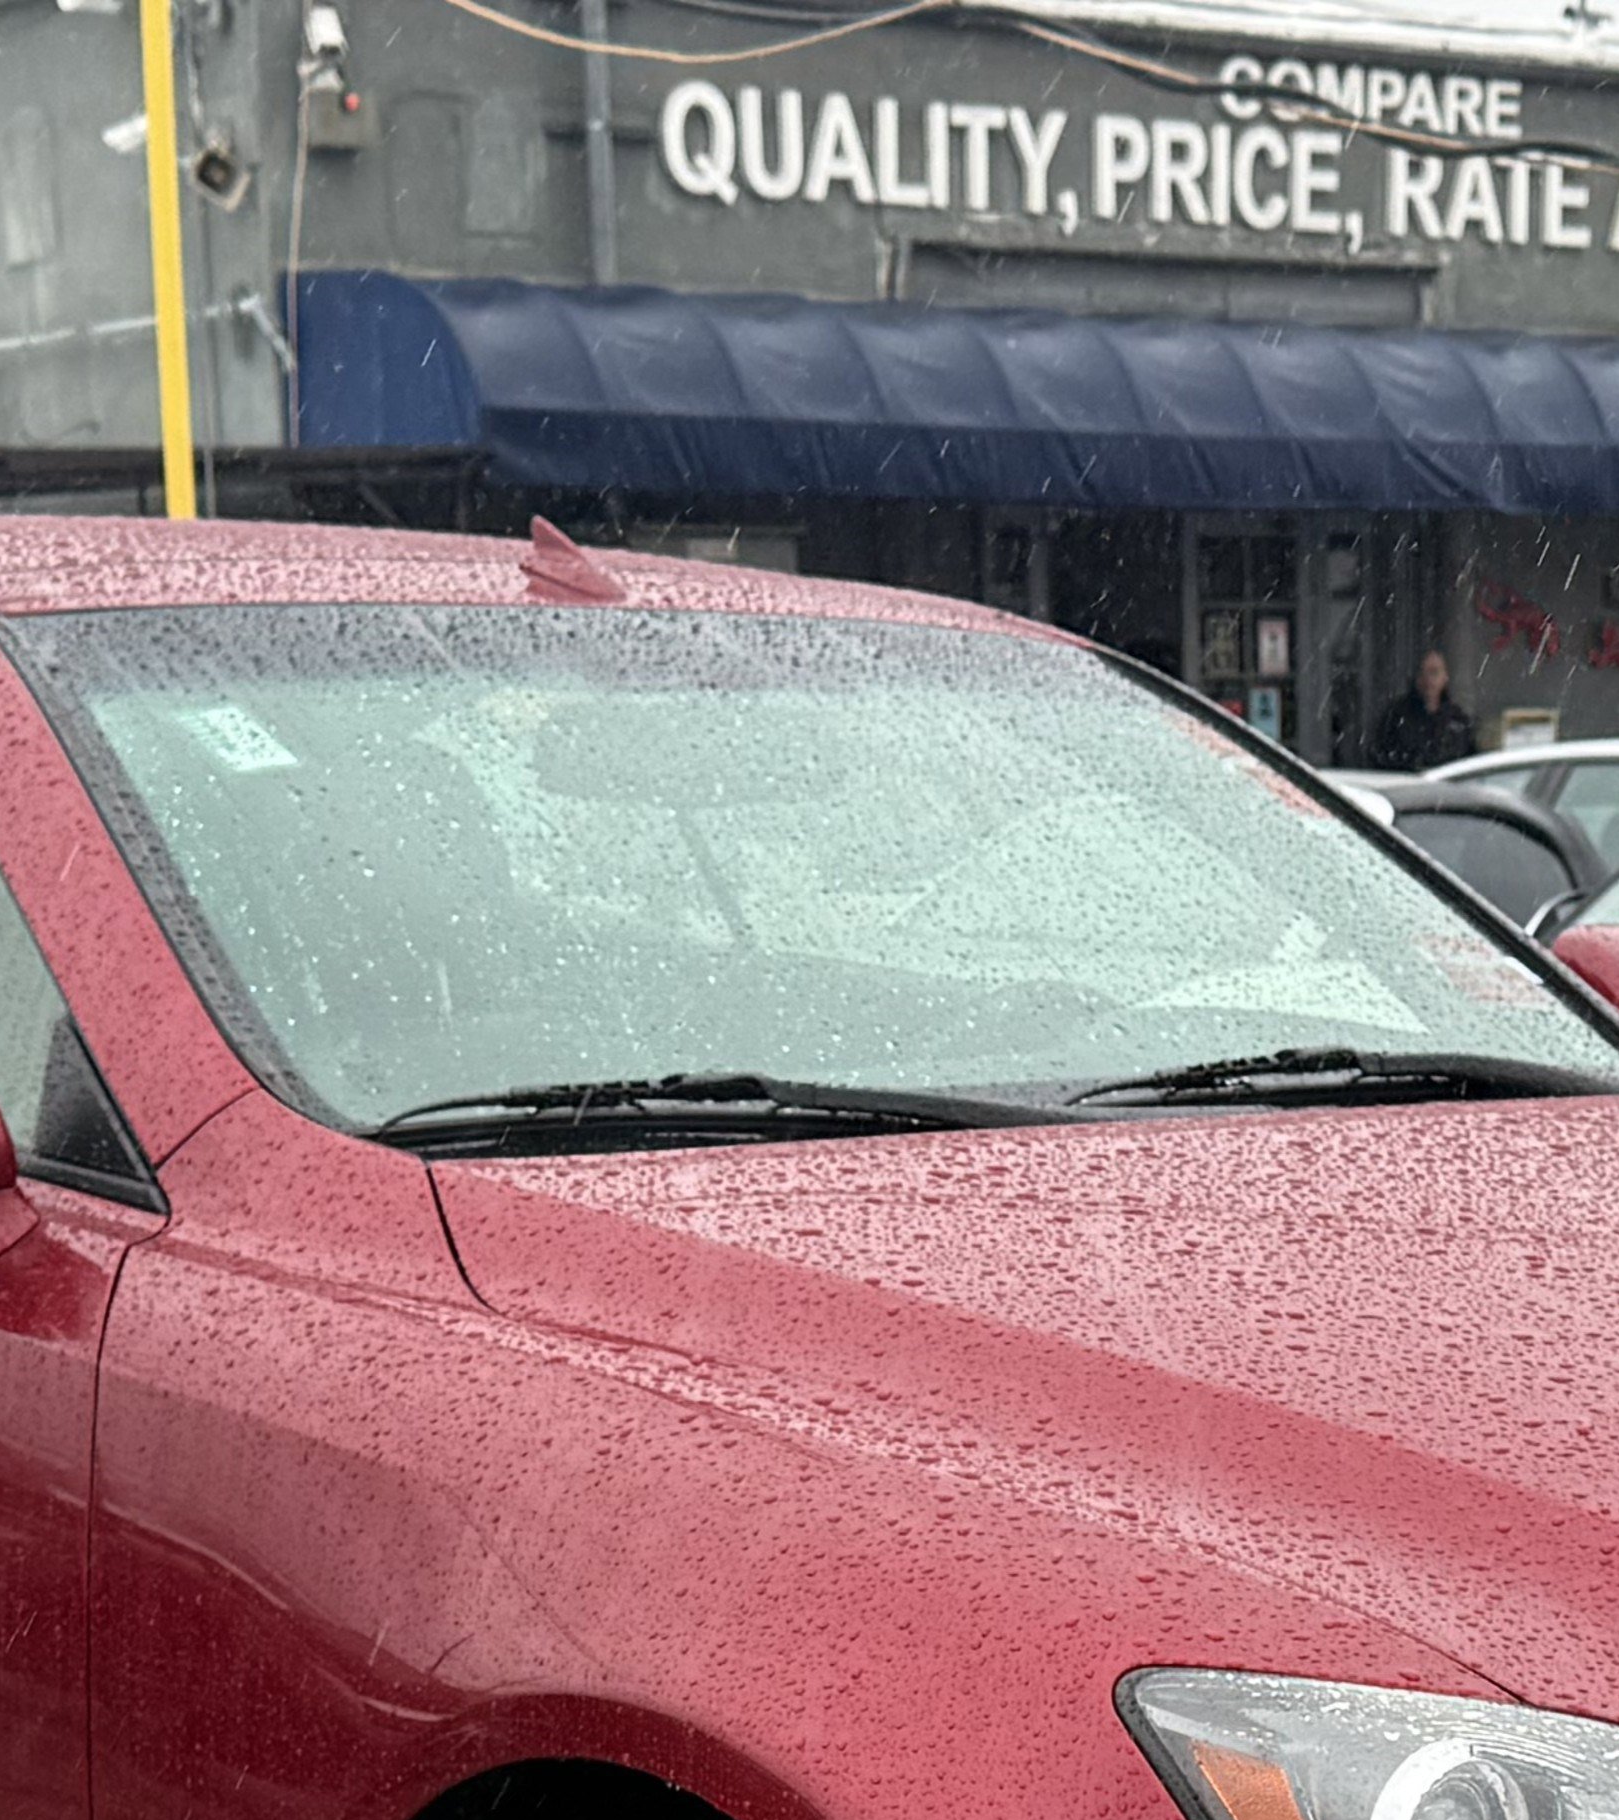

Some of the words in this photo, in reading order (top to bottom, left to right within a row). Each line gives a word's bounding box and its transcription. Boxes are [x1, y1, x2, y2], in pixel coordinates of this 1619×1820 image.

[1220, 55, 1523, 140] COMPARE
[660, 79, 1080, 236] QUALITY,
[1091, 112, 1366, 252] PRICE,
[1388, 144, 1591, 249] RATE
